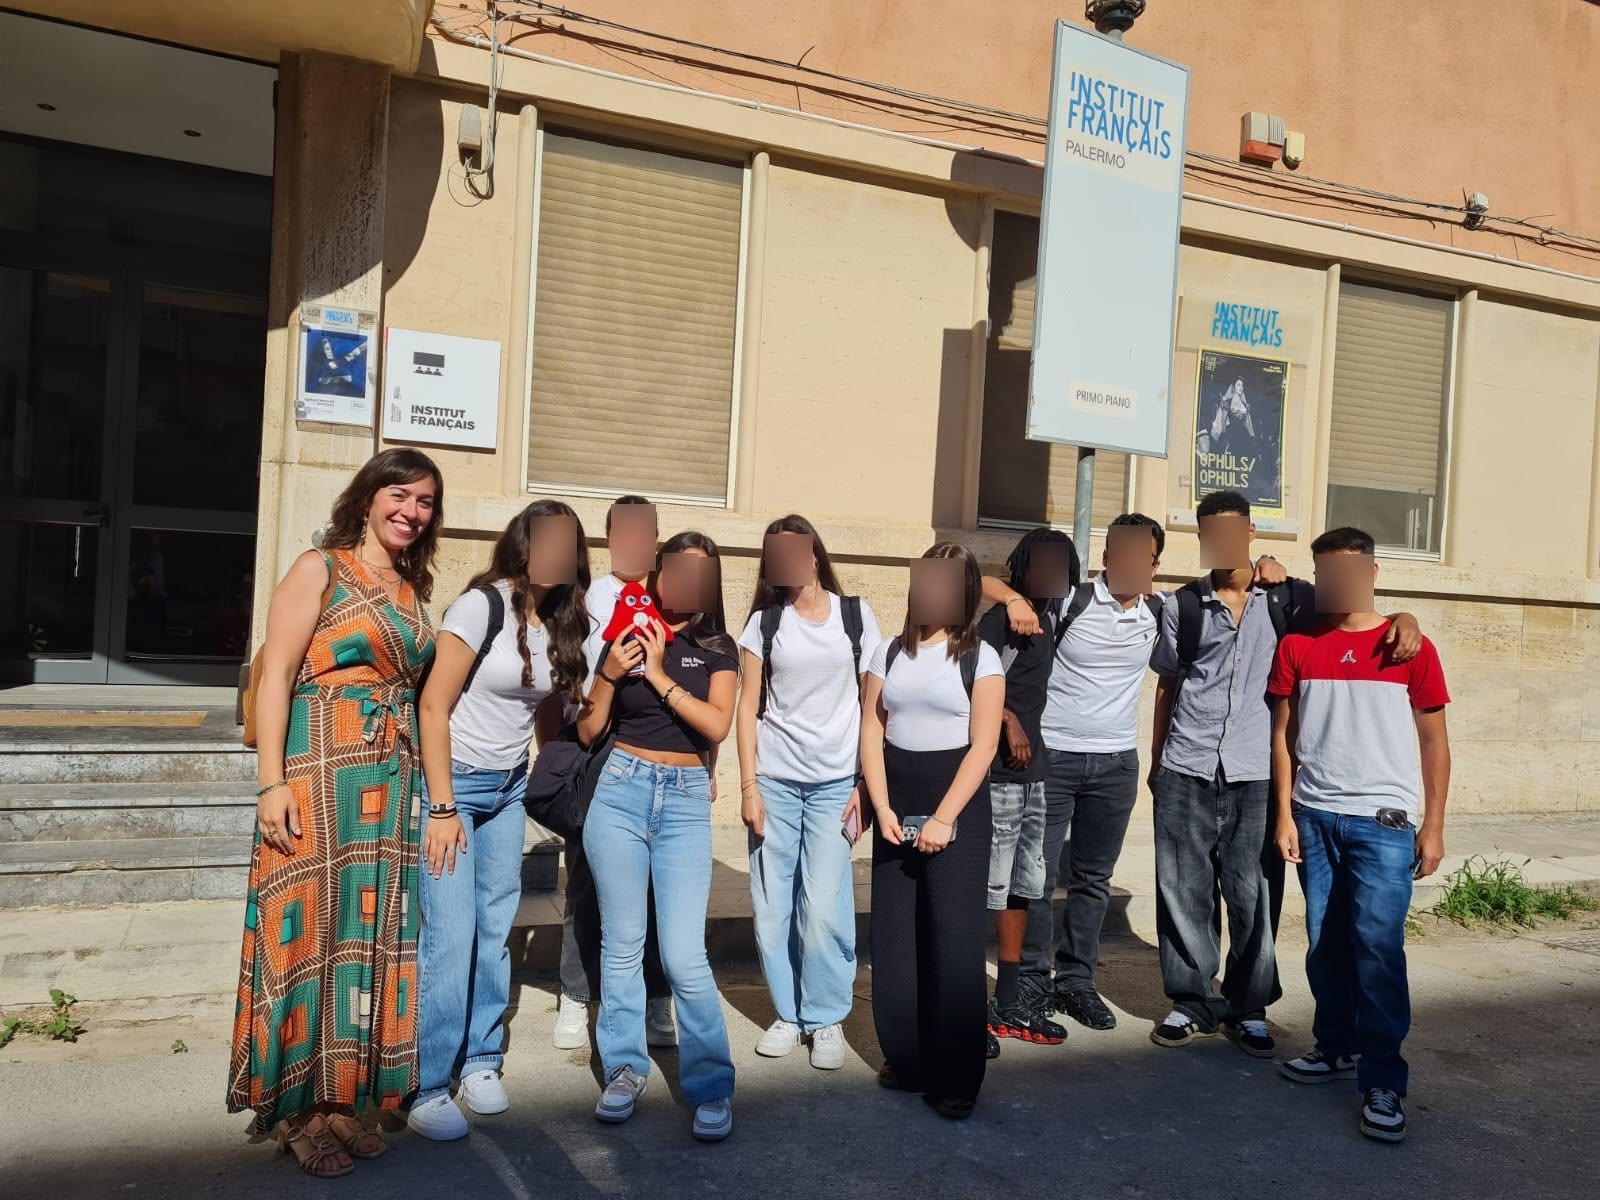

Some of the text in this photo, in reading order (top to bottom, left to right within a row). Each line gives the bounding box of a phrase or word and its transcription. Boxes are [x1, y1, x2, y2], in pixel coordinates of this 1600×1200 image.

[1070, 72, 1164, 130] INSTITUT
[1067, 98, 1171, 159] FRANÇAIS
[1065, 140, 1126, 169] PALERMO
[1215, 301, 1279, 329] INSTITUT
[1212, 318, 1283, 347] FRANÇAIS
[410, 404, 466, 418] INSTITUT
[1076, 390, 1131, 408] PRIMO PIANO
[410, 415, 476, 431] FRANÇAIS
[1199, 469, 1249, 488] OPHULS
